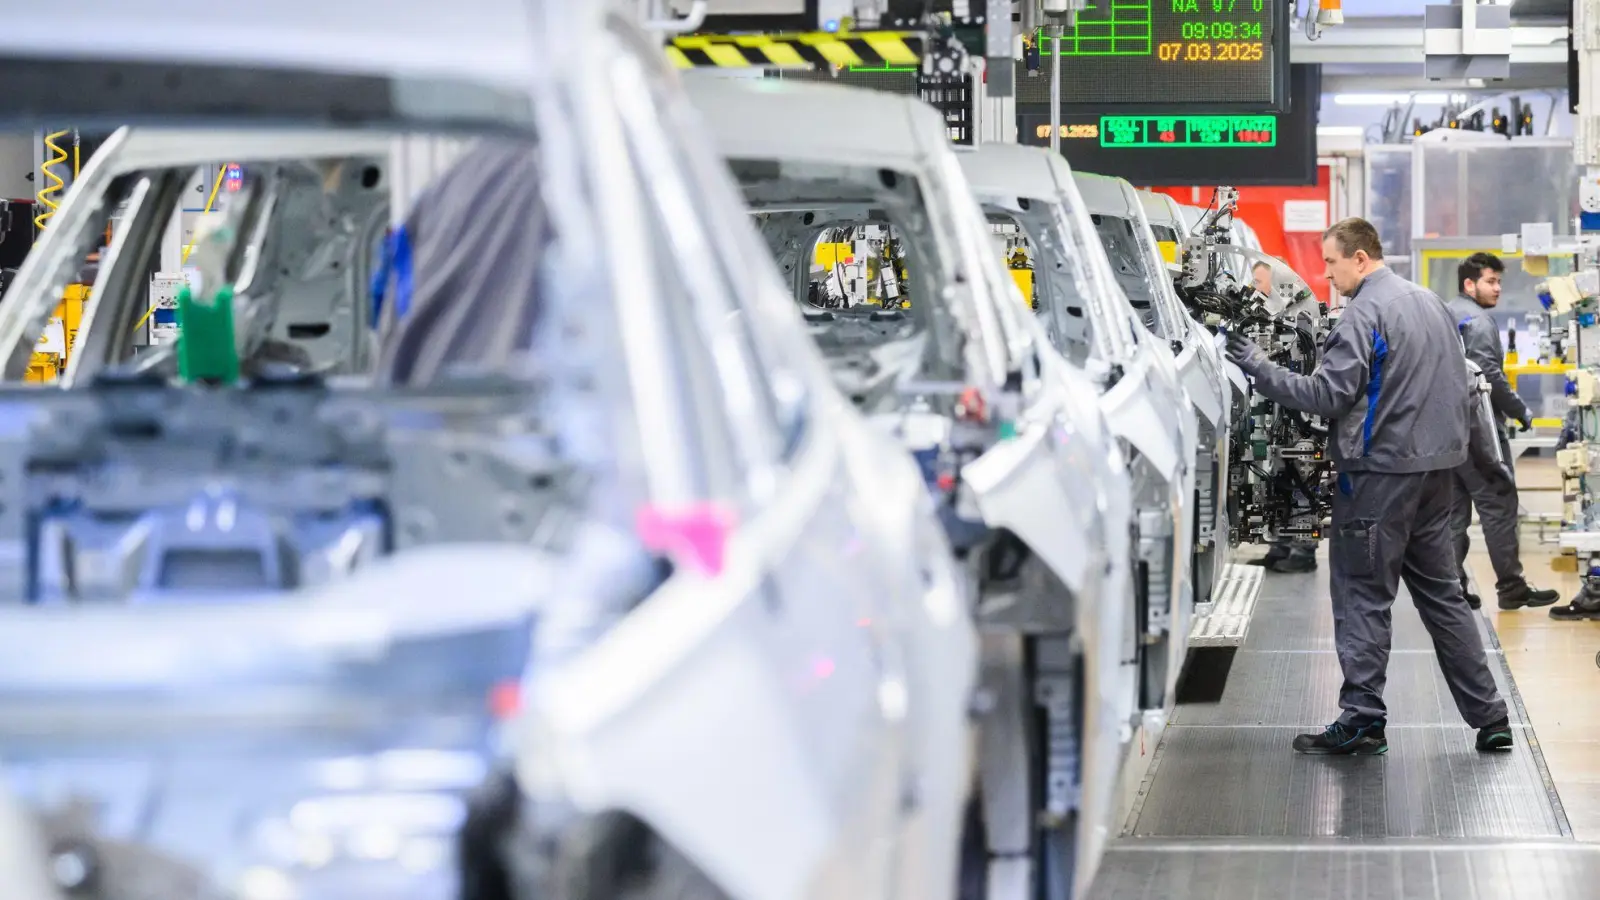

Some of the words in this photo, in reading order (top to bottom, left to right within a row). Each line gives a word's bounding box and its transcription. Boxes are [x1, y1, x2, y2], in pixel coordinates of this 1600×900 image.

[1172, 0, 1199, 12] NA
[1182, 22, 1262, 39] 09:09:34
[1159, 43, 1263, 60] 07.03.2025
[1036, 125, 1098, 138] 073.2025
